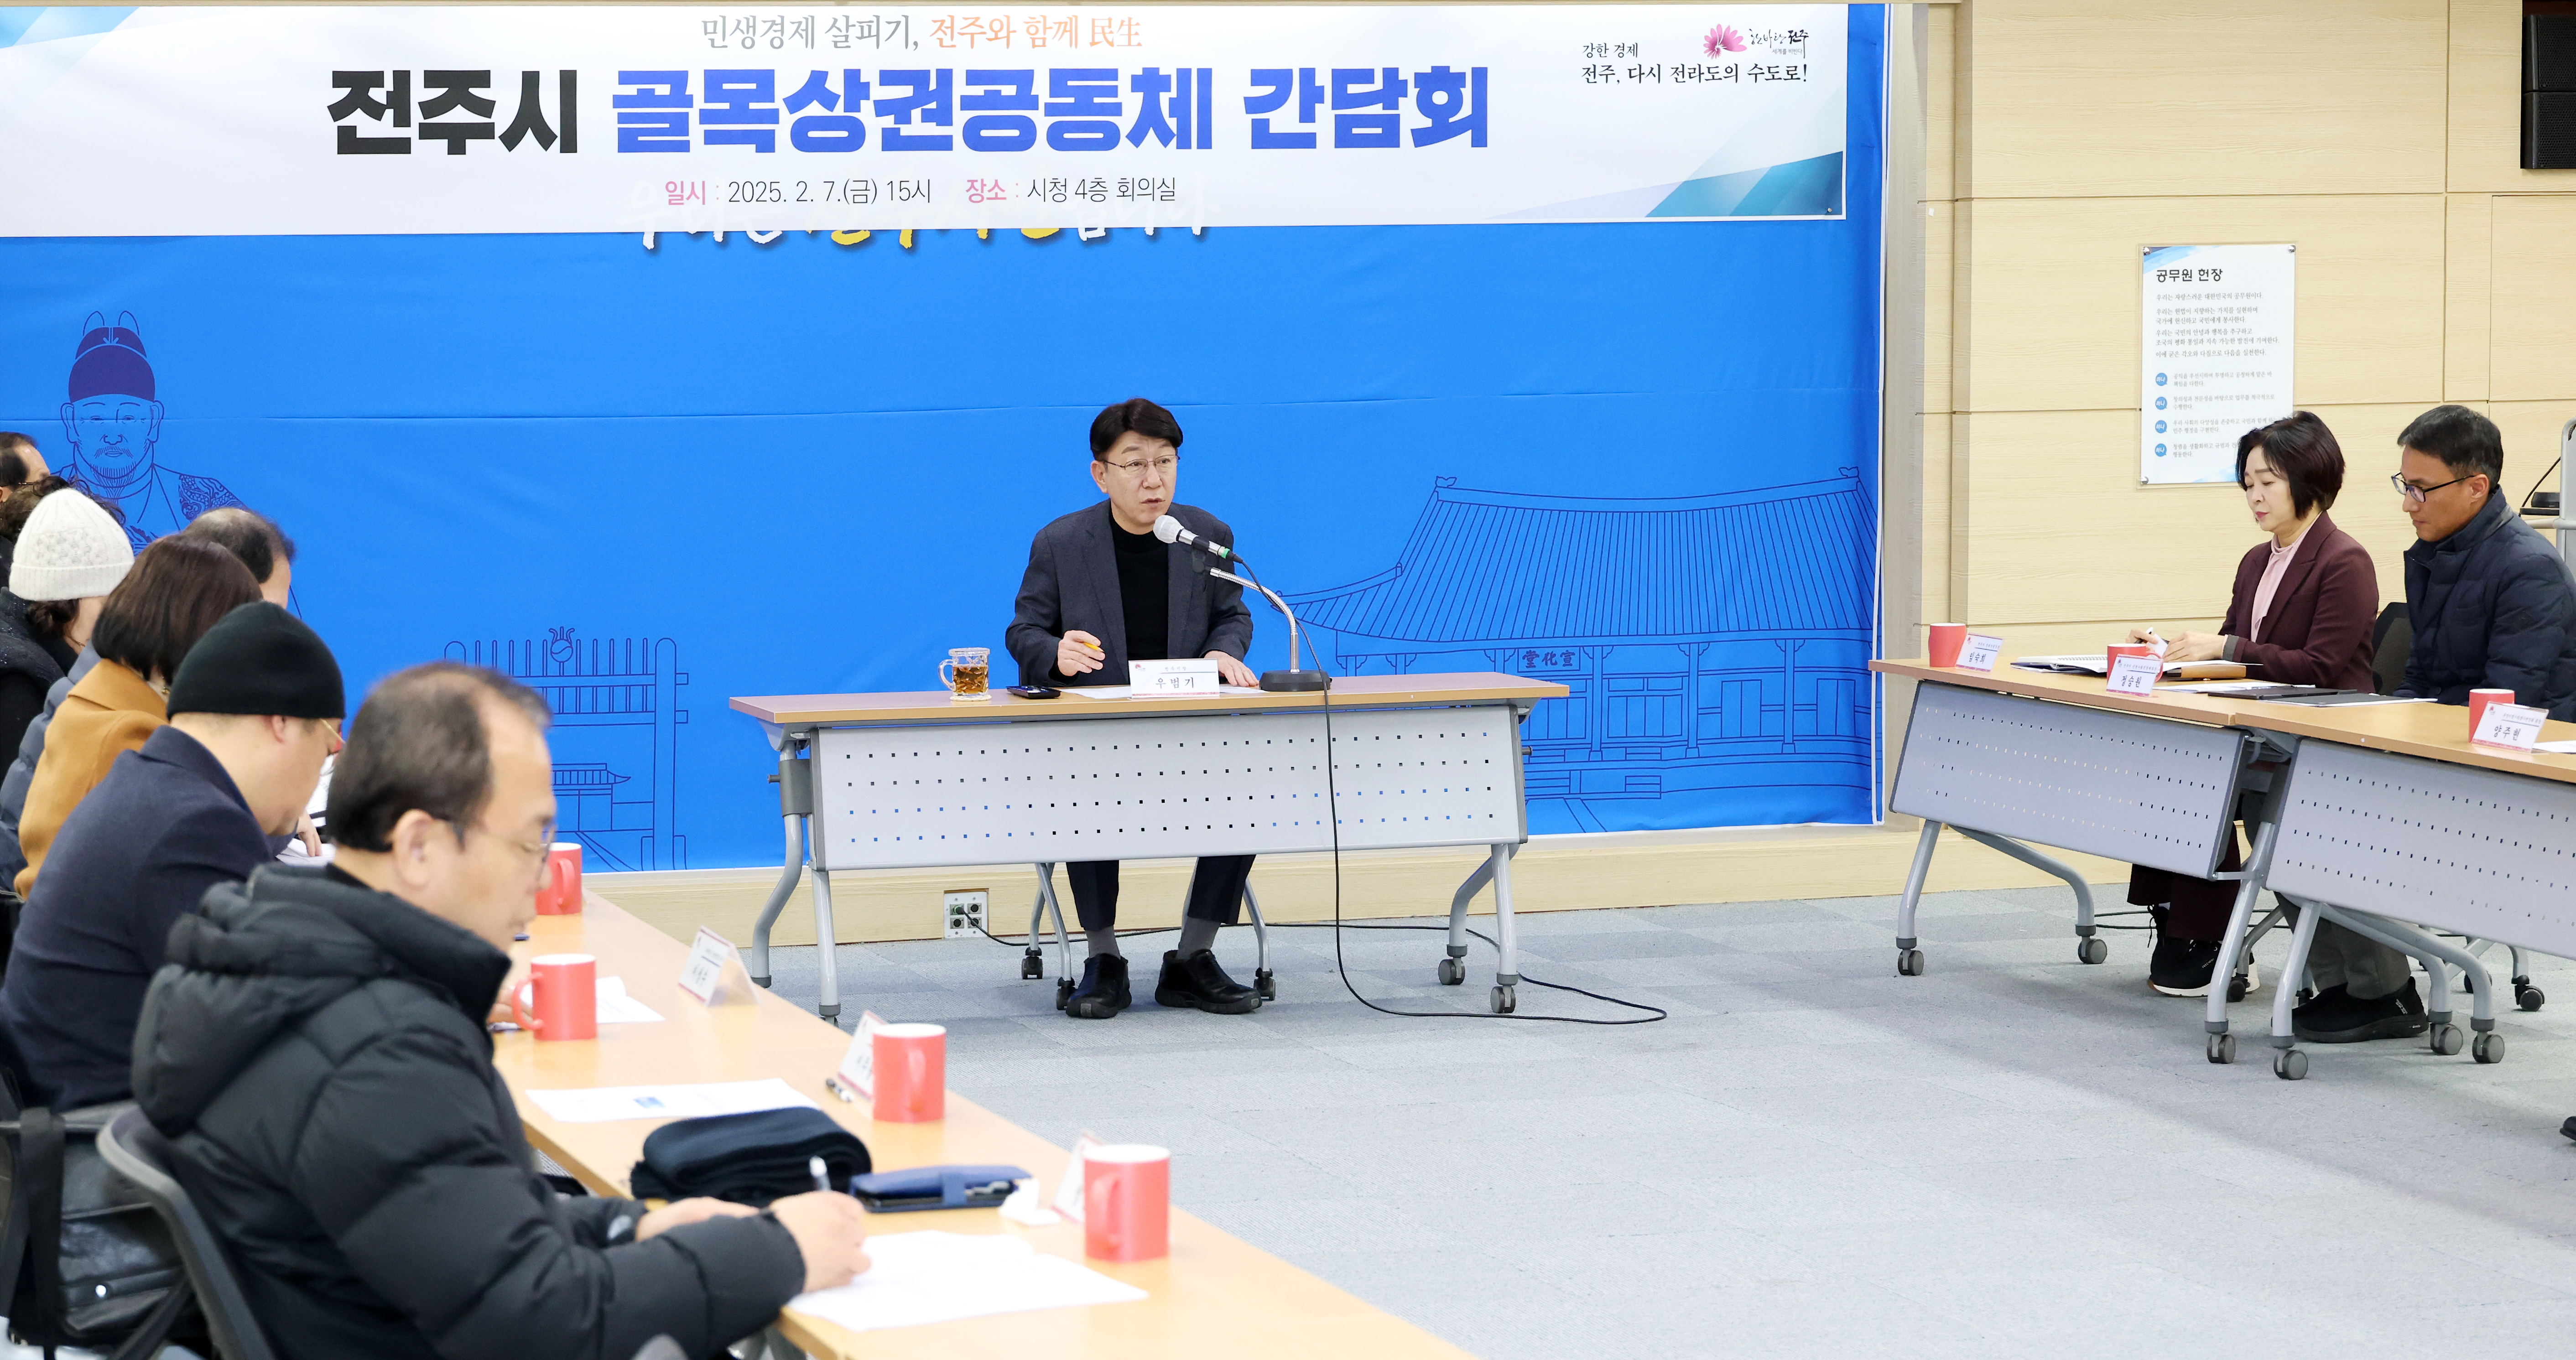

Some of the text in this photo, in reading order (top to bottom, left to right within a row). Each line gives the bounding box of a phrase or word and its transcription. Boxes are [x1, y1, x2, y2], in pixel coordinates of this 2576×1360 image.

[702, 15, 1142, 51] 민생경제 살피기, 전주와 함께 民生
[1788, 30, 1809, 58] 전주
[1583, 43, 1638, 58] 강한 경제
[1582, 63, 1806, 84] 전주, 다시 전라도의 수도로!
[327, 66, 1488, 155] 전주시 골목상권공동체 간담회
[666, 181, 705, 205] 일시
[729, 181, 786, 202] 2025.
[796, 181, 813, 202] 2.
[823, 179, 877, 204] 7.(금)
[887, 179, 930, 203] 15시
[966, 179, 1006, 203] 장소
[1028, 178, 1067, 202] 시청
[1075, 178, 1108, 202] 4층
[1117, 177, 1175, 201] 회의실
[2156, 269, 2222, 282] 공무원 헌장
[2494, 725, 2521, 741] 양주현
